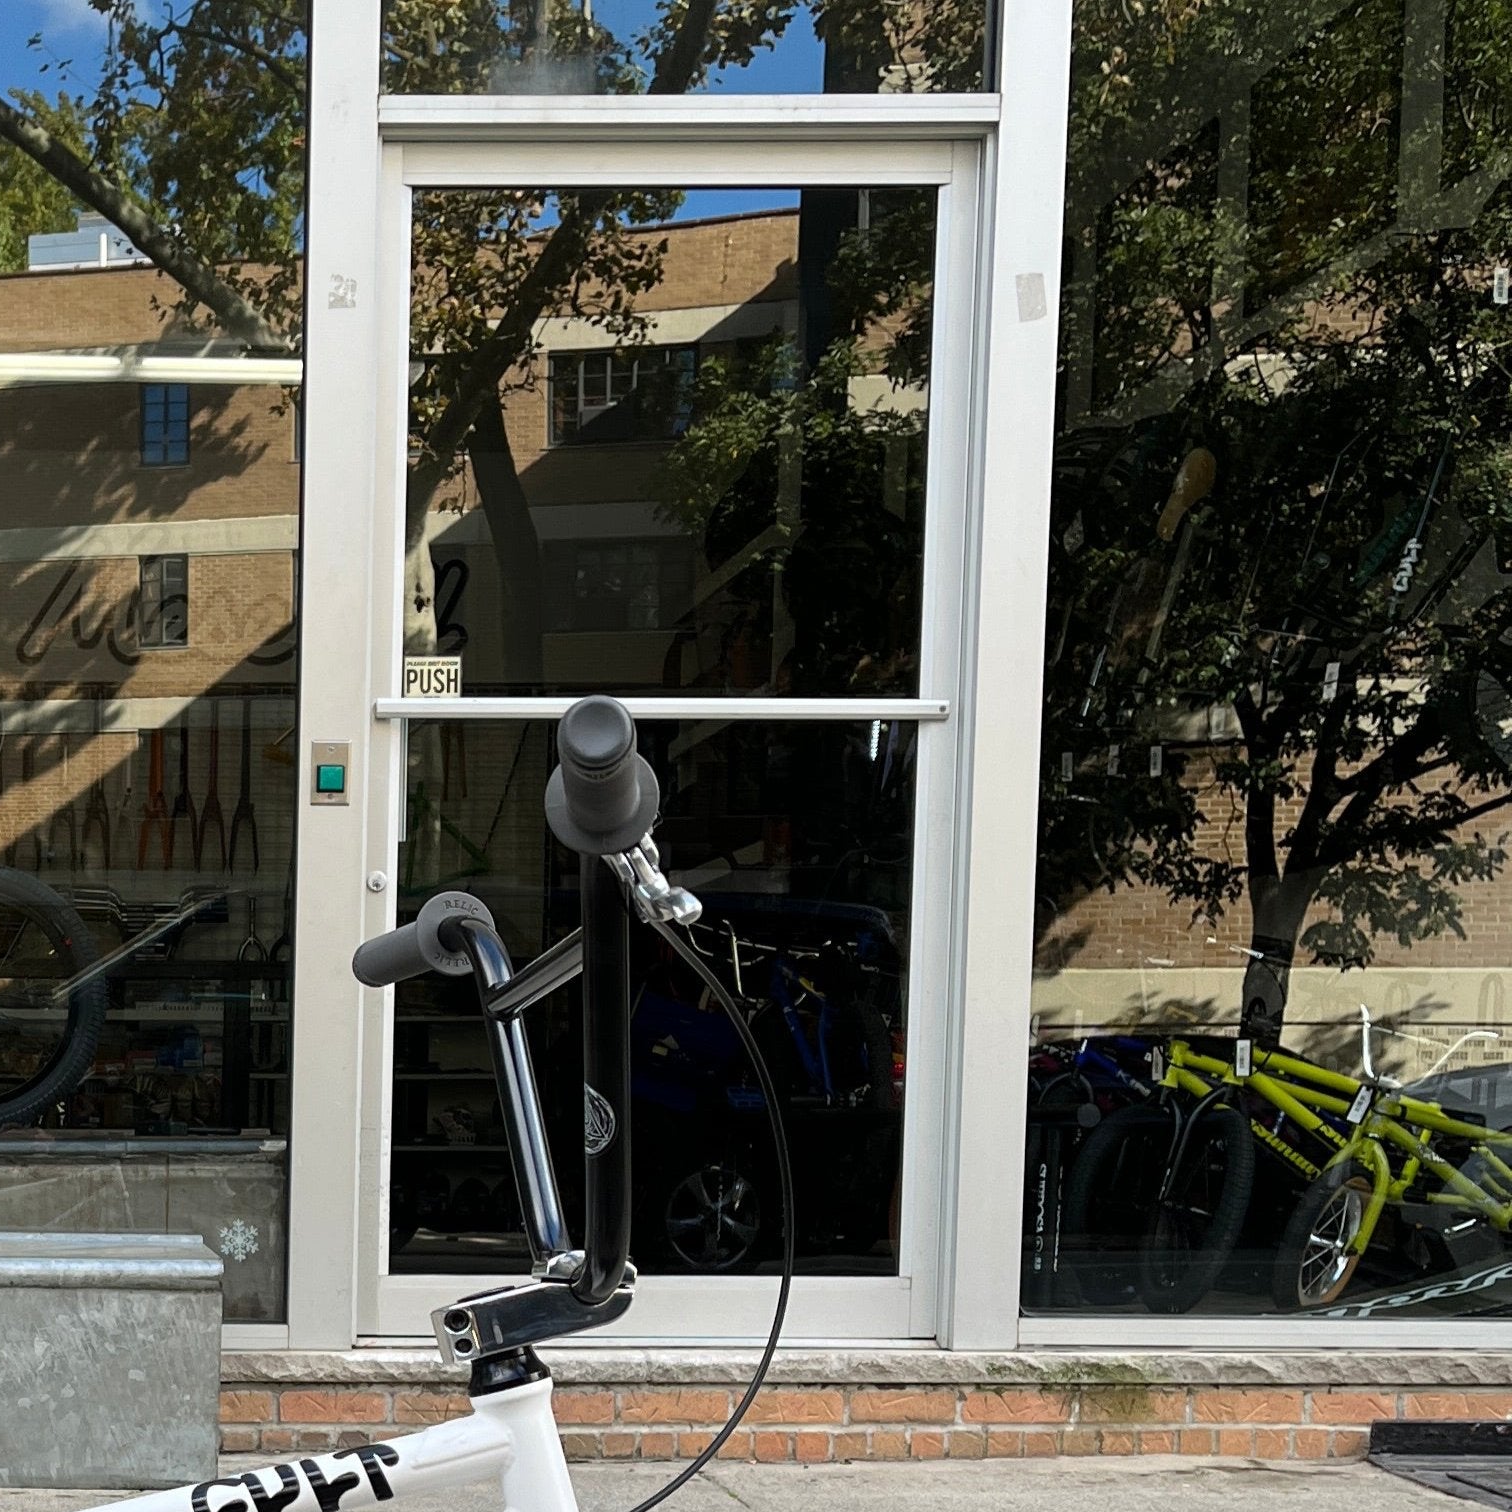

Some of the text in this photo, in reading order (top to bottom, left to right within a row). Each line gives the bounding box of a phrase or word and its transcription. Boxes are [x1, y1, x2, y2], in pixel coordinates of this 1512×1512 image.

[406, 668, 459, 694] PUSH
[443, 899, 479, 916] RELIC
[434, 952, 471, 968] RELIC
